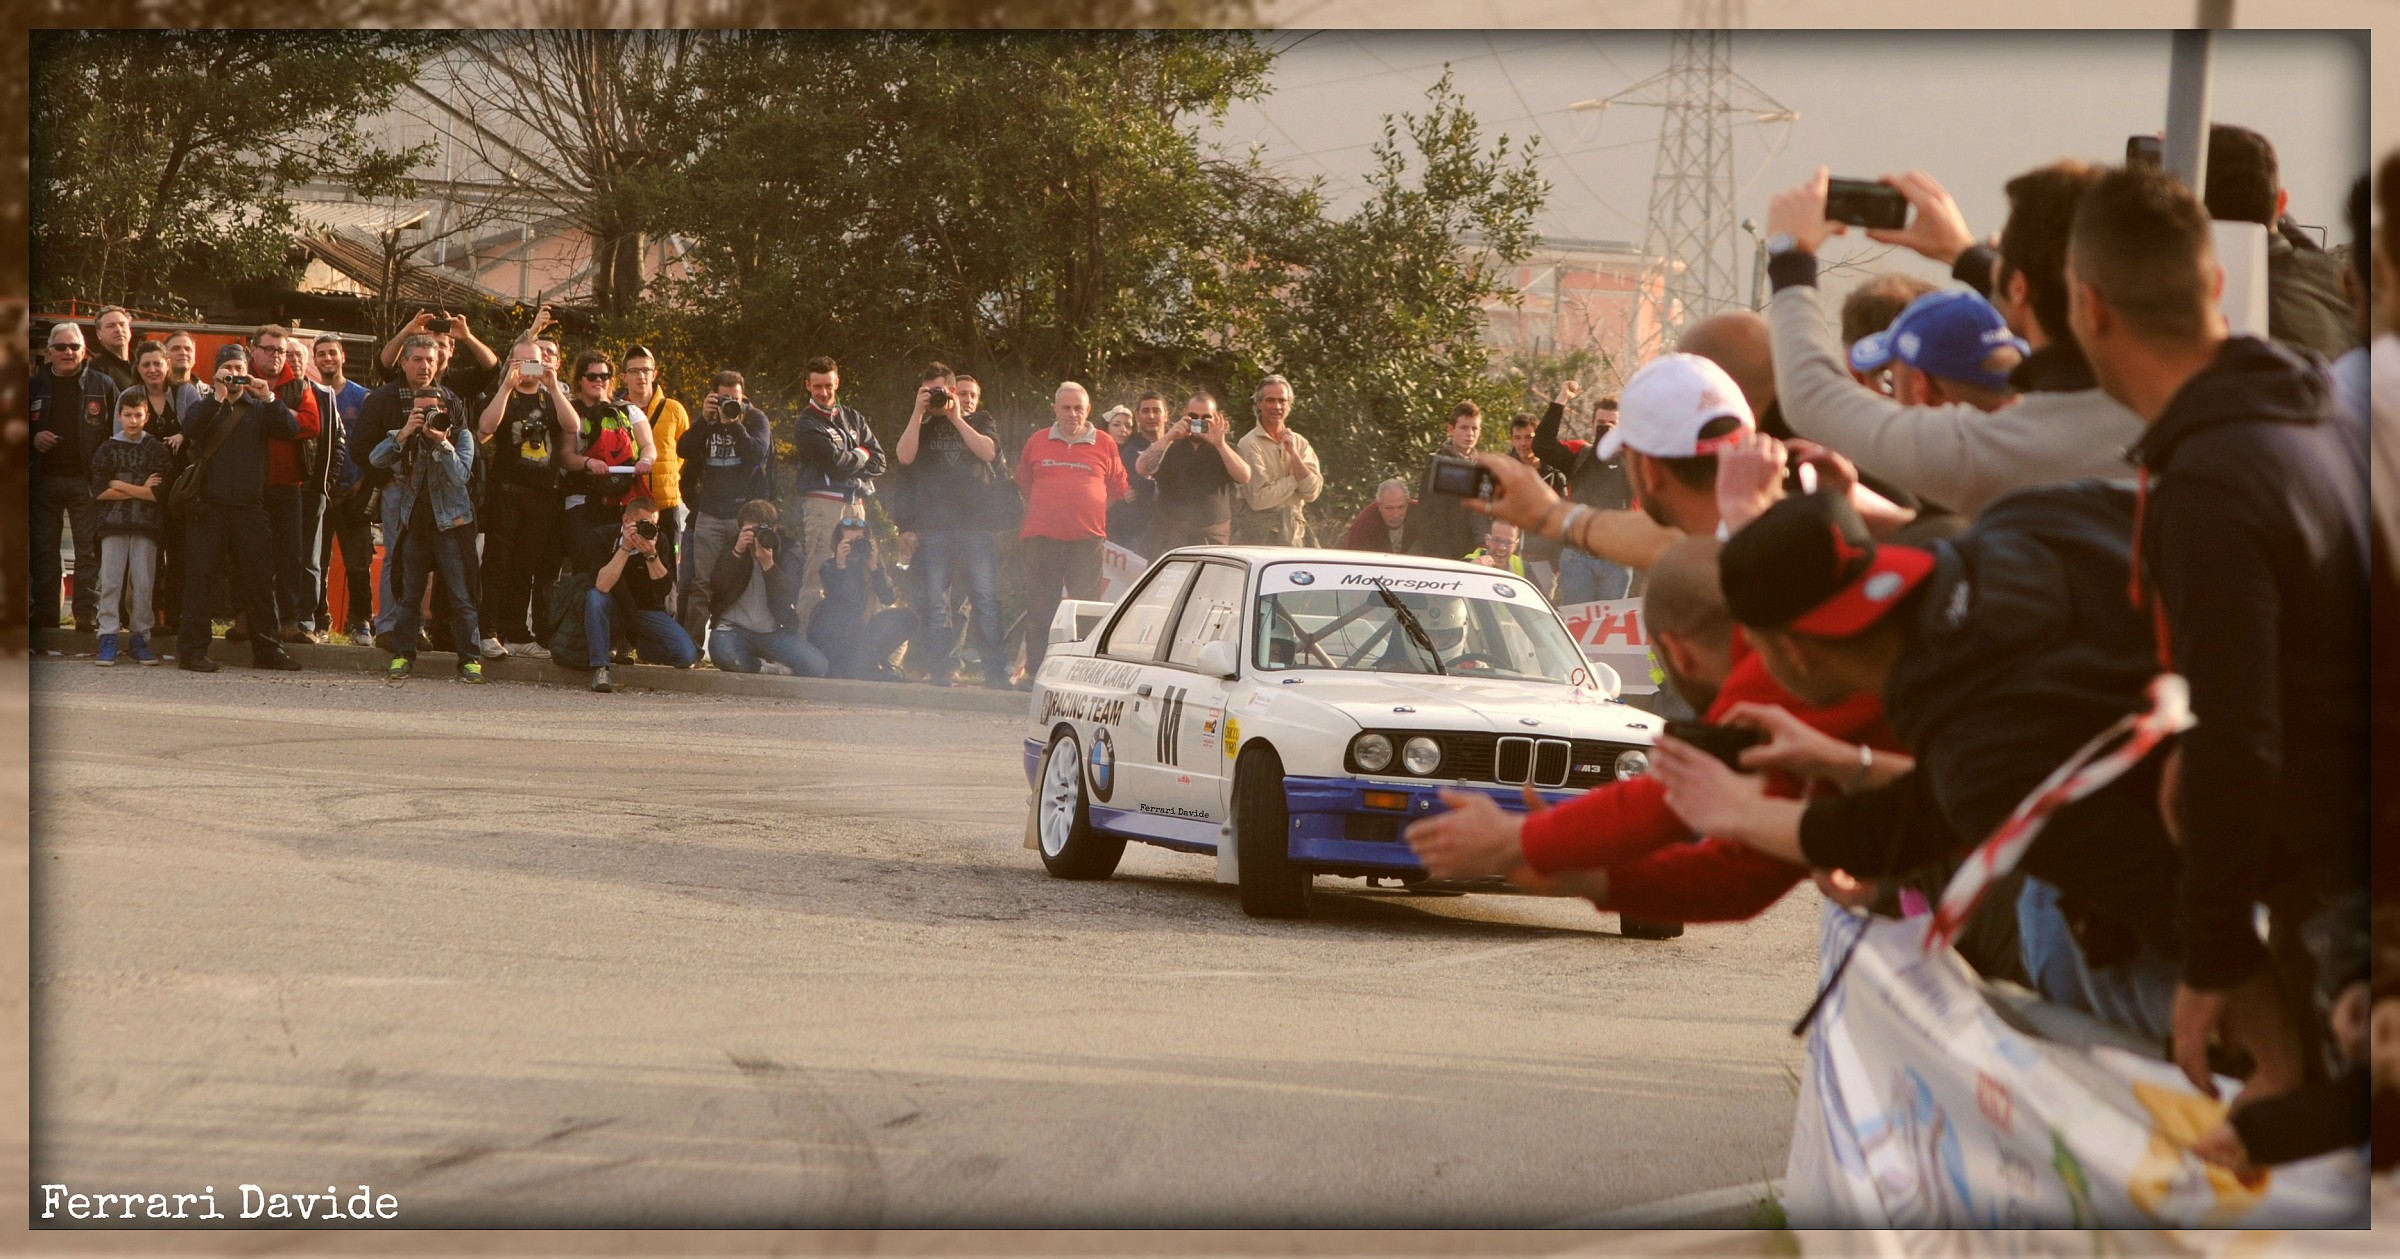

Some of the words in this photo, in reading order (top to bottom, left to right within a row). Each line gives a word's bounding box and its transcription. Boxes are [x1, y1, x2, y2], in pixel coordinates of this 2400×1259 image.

[1340, 574, 1463, 591] Motorsport
[1066, 659, 1110, 684] FERRARI
[1103, 664, 1142, 690] CARLO
[1049, 691, 1088, 719] RACING
[1087, 696, 1124, 727] TEAM
[1157, 686, 1187, 767] M
